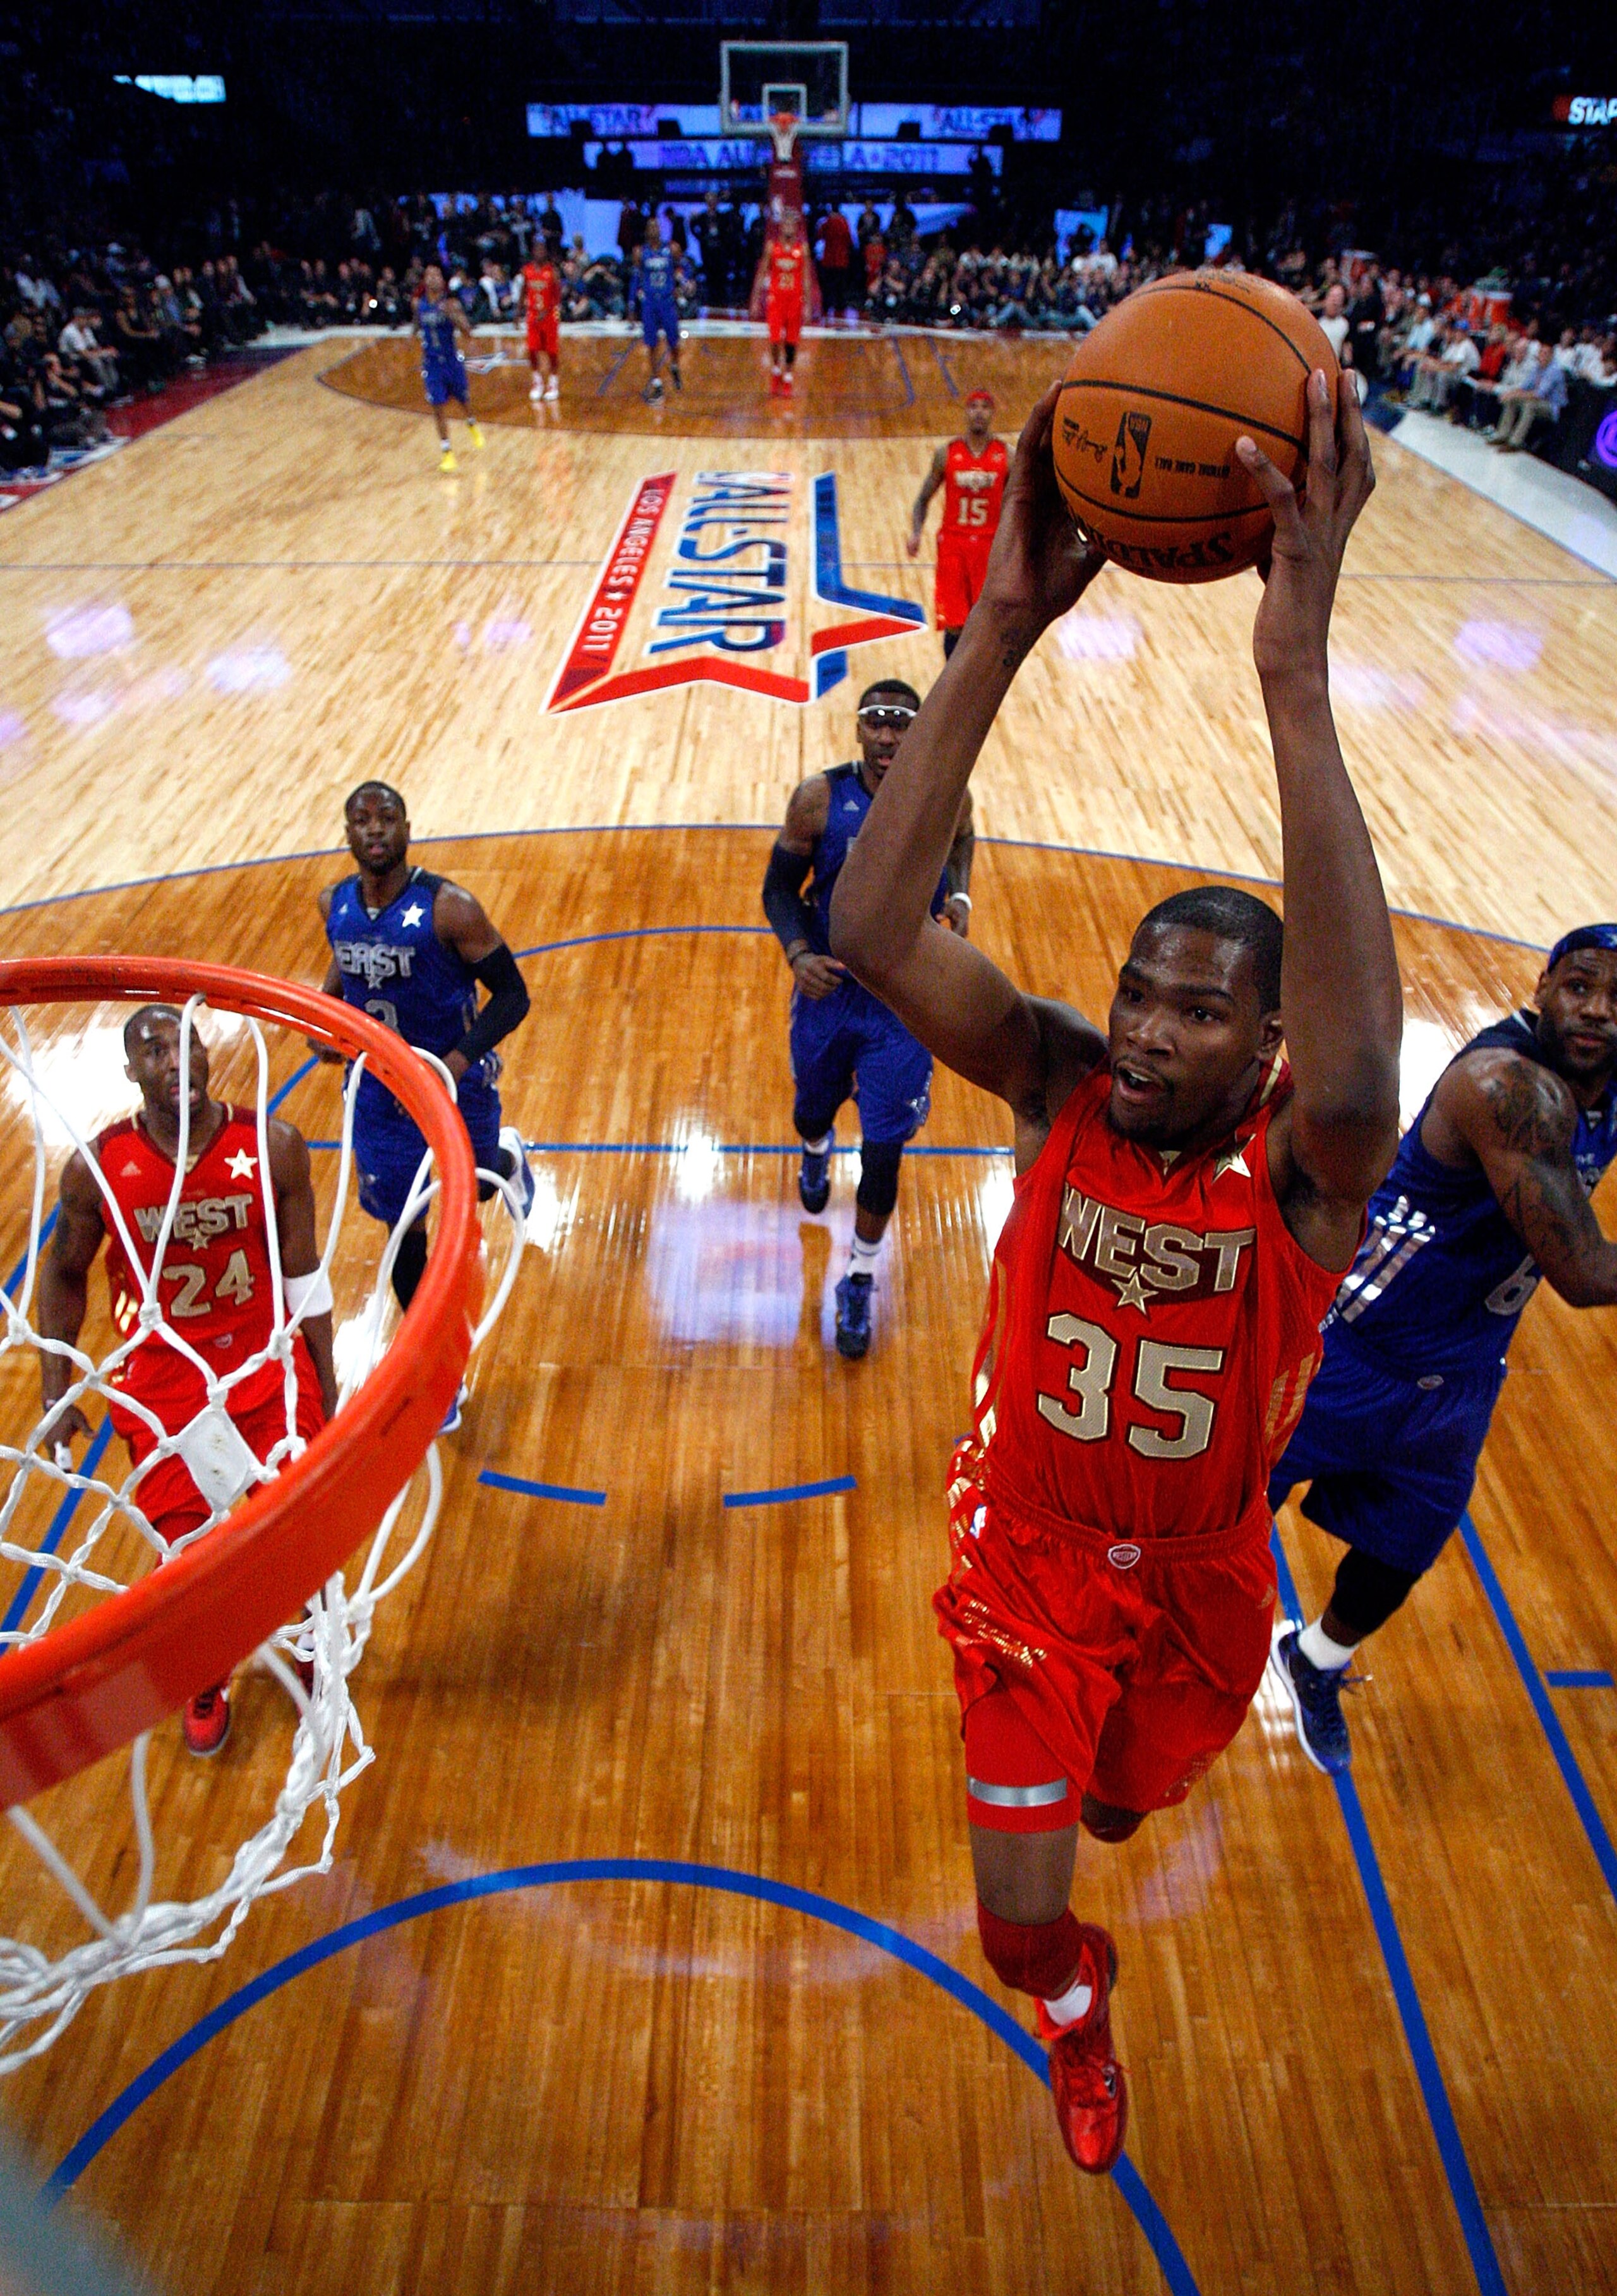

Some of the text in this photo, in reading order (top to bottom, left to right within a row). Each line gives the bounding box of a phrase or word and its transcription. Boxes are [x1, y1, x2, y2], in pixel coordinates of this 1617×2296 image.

[956, 496, 989, 526] 15
[581, 488, 665, 651] LOS ANGELES 2011
[334, 940, 416, 978] EAST
[133, 1193, 253, 1243] WEST
[1057, 1181, 1257, 1292] WEST
[162, 1249, 255, 1318] 24
[1037, 1313, 1224, 1459] 35
